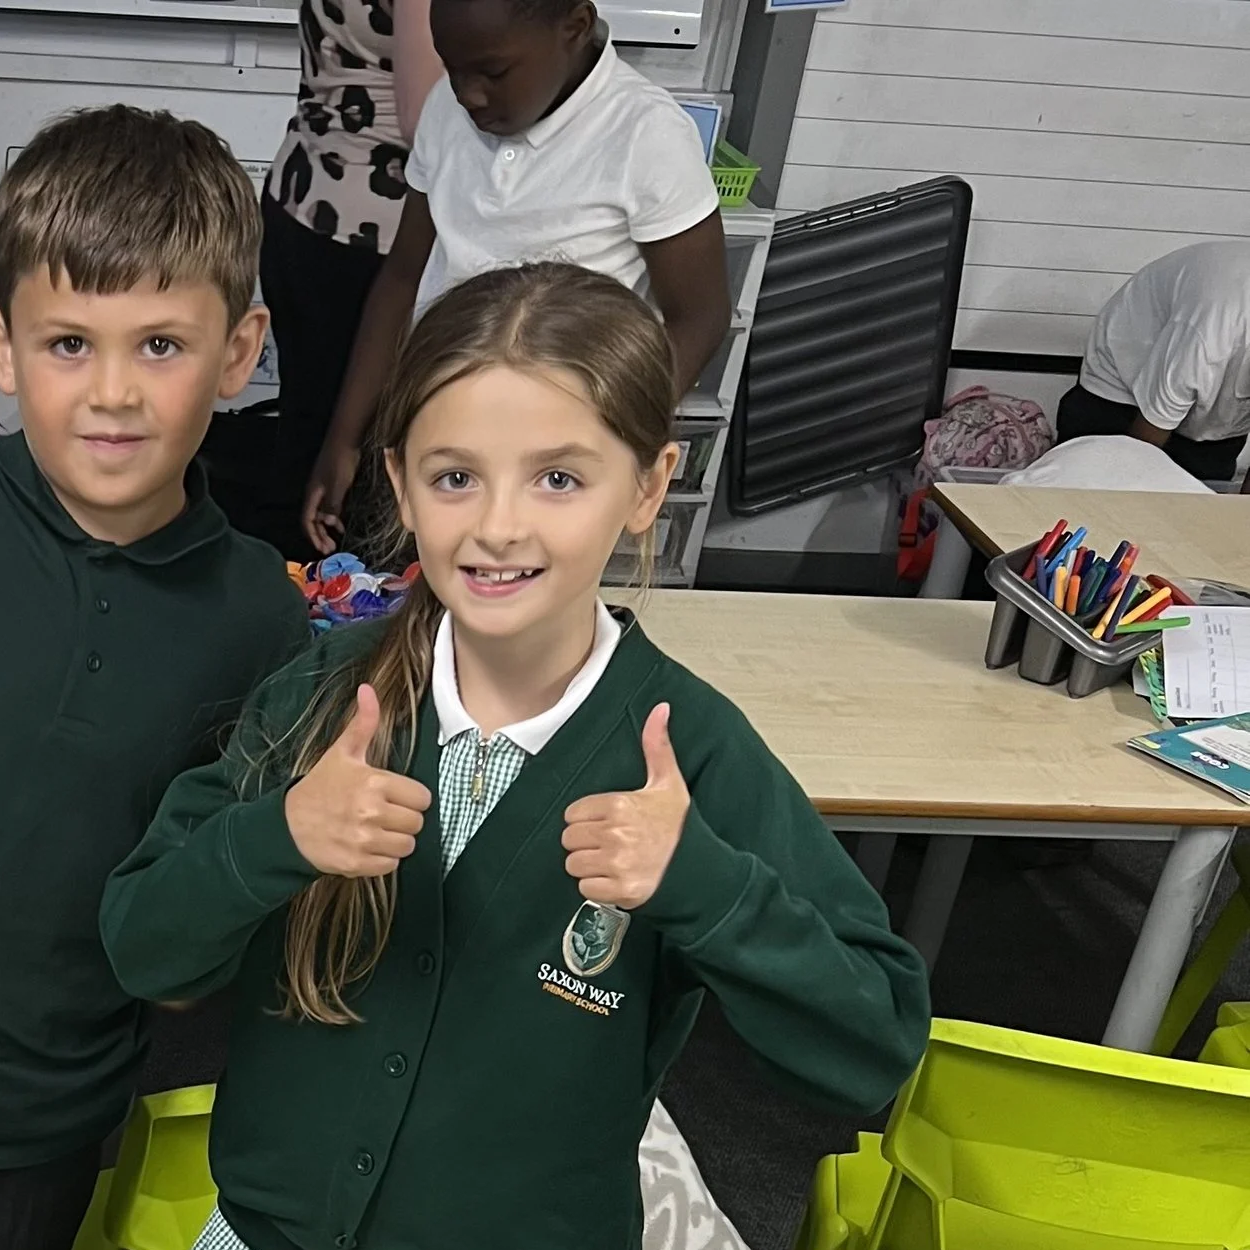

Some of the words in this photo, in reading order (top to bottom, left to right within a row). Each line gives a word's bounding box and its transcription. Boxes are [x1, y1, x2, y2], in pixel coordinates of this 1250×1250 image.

[537, 963, 587, 995] SAXON
[589, 985, 625, 1009] WAY
[542, 982, 577, 1003] PRIMARY
[575, 997, 610, 1016] SCHOOL
